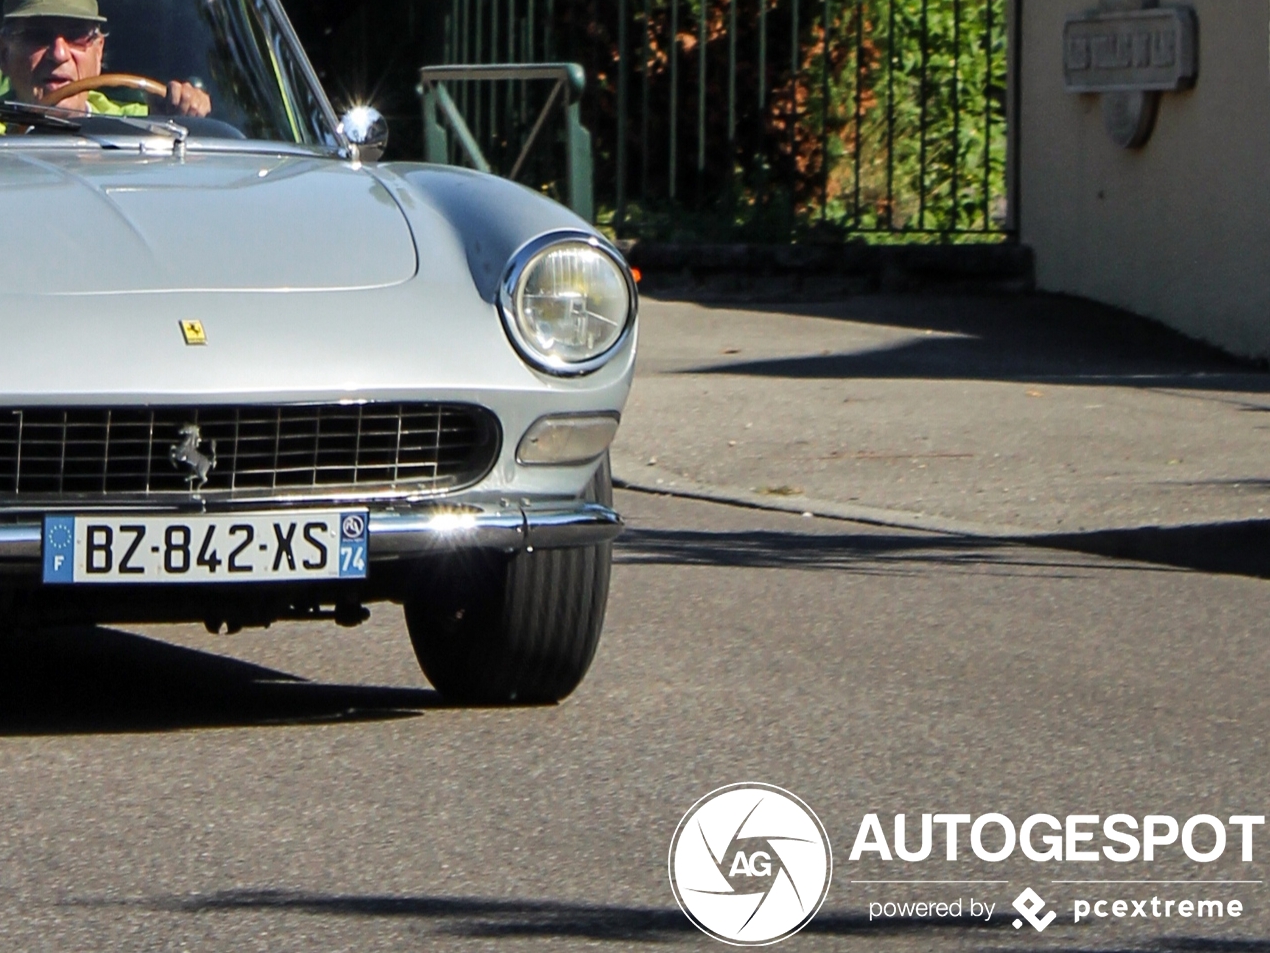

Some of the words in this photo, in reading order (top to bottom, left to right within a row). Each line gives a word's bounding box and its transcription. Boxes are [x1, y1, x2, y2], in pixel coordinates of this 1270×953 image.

[86, 522, 328, 574] BZ-842-XS
[340, 546, 365, 572] 74
[54, 555, 65, 571] F
